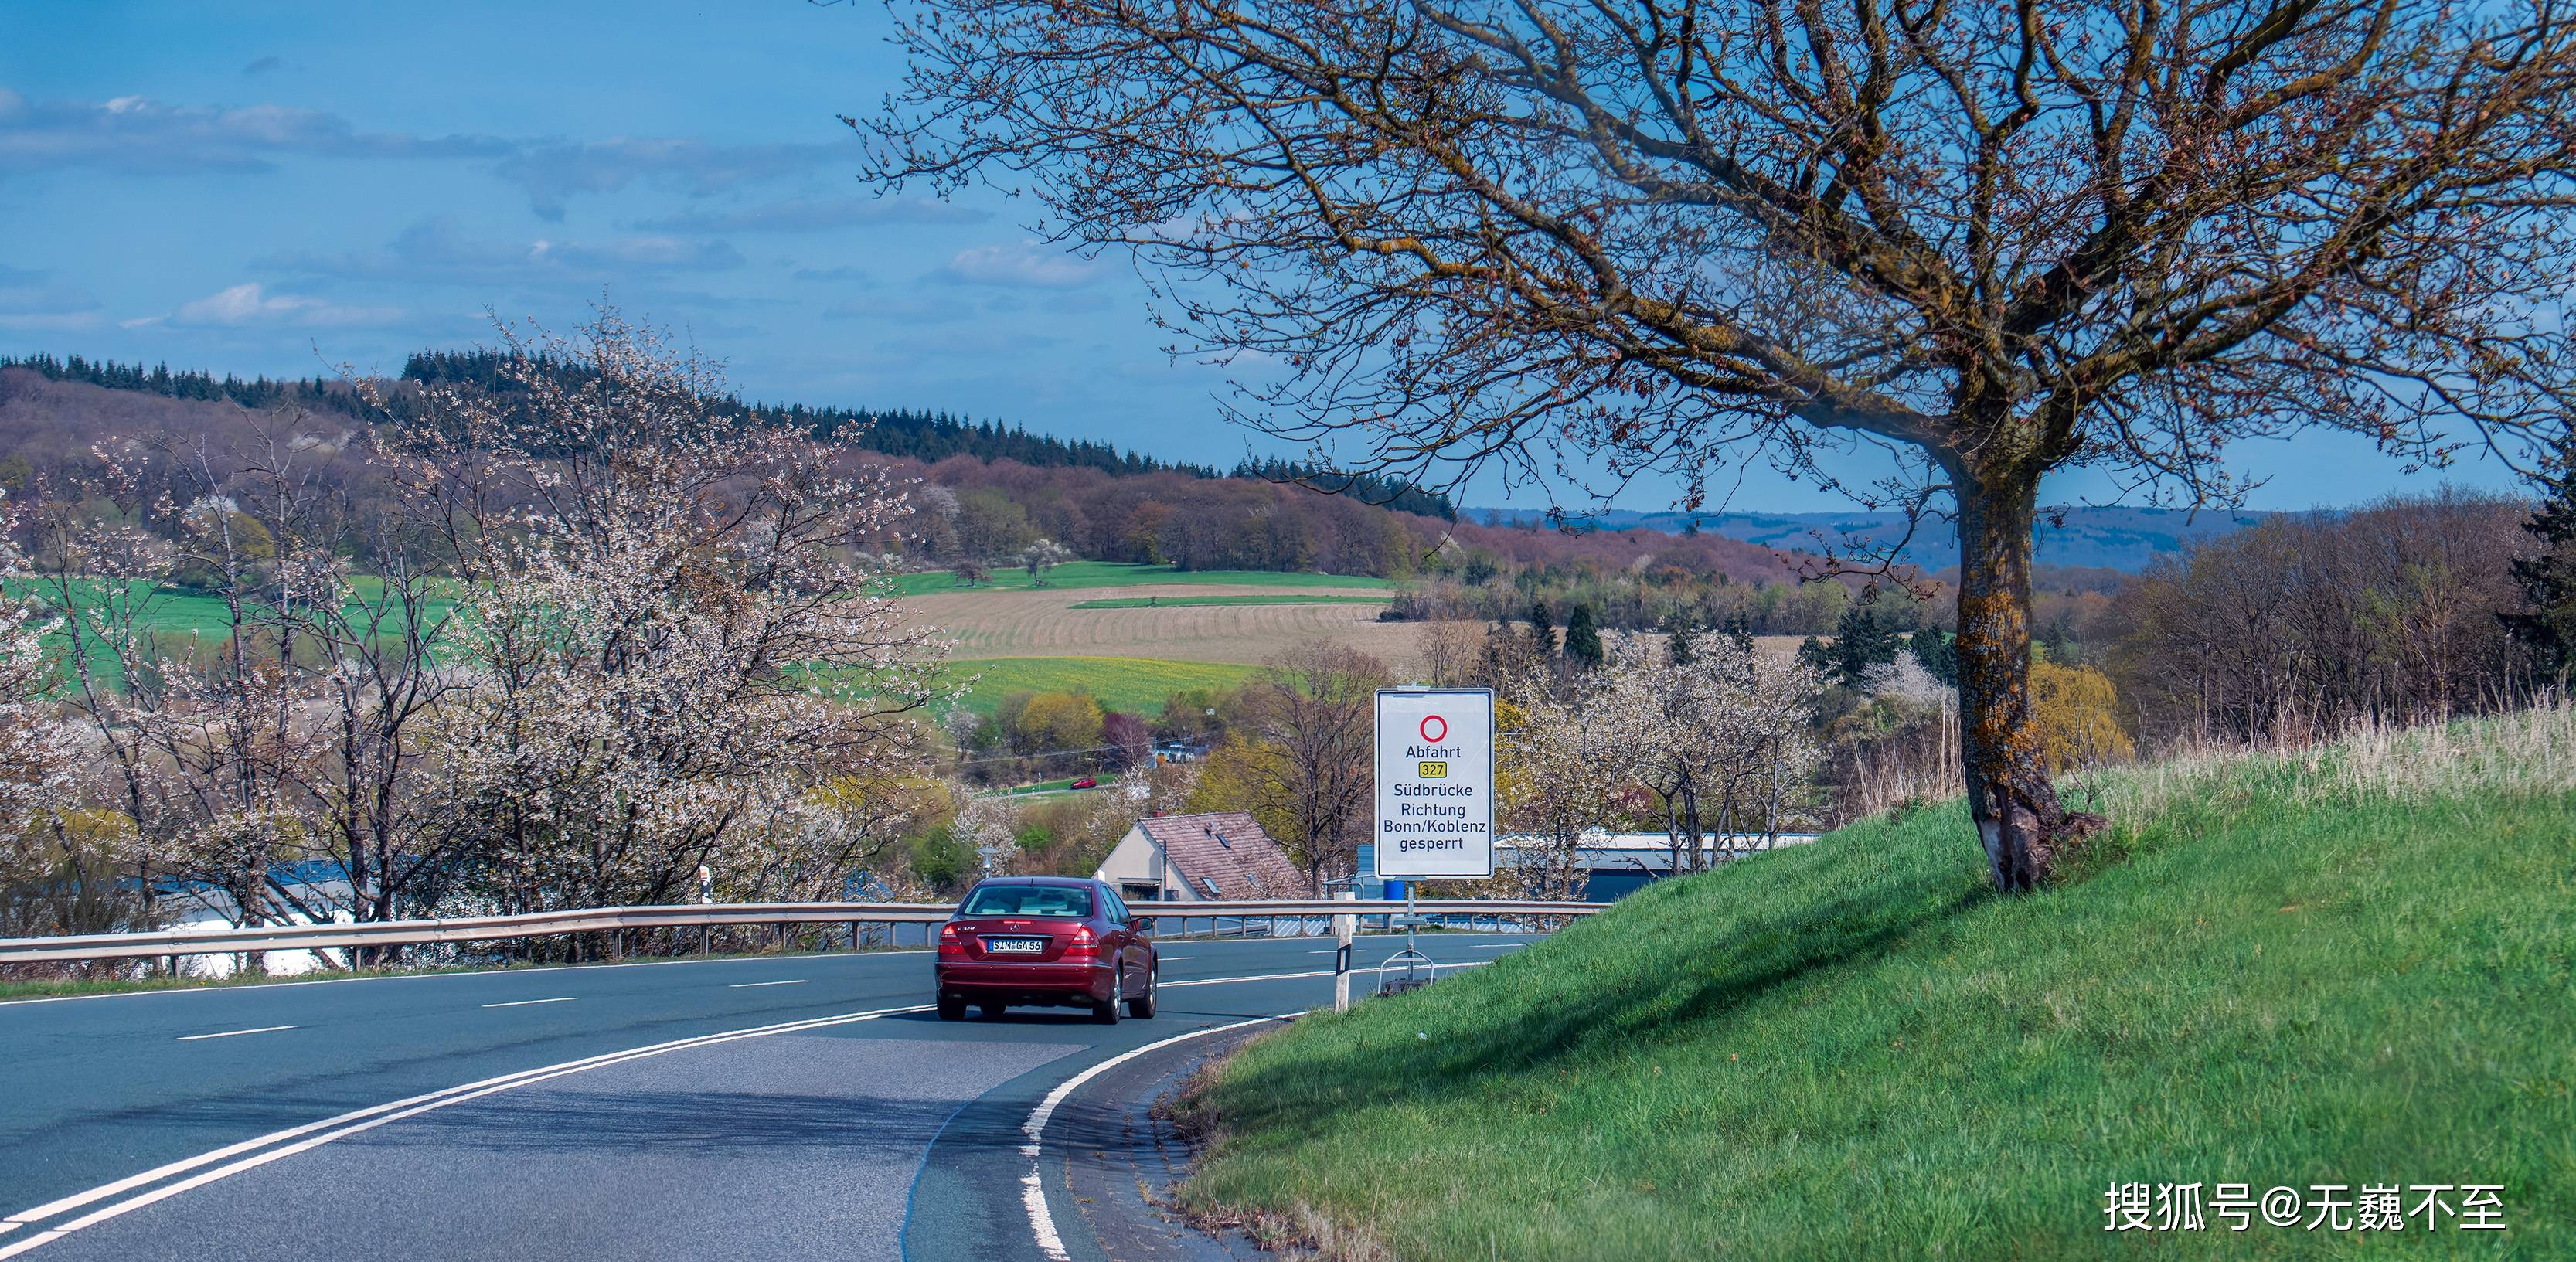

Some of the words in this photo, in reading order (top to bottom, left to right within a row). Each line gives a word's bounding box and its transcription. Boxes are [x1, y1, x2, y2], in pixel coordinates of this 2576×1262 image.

[1406, 746, 1461, 758] Abfahrt
[1422, 765, 1444, 775] 327
[1394, 784, 1472, 796] Südbrücke
[1401, 803, 1465, 818] Richtung
[1384, 820, 1486, 832] Bonn/Koblenz
[1400, 838, 1463, 852] gesperrt
[994, 941, 1011, 950] SIM
[1016, 941, 1028, 950] GA
[1029, 941, 1040, 950] 56
